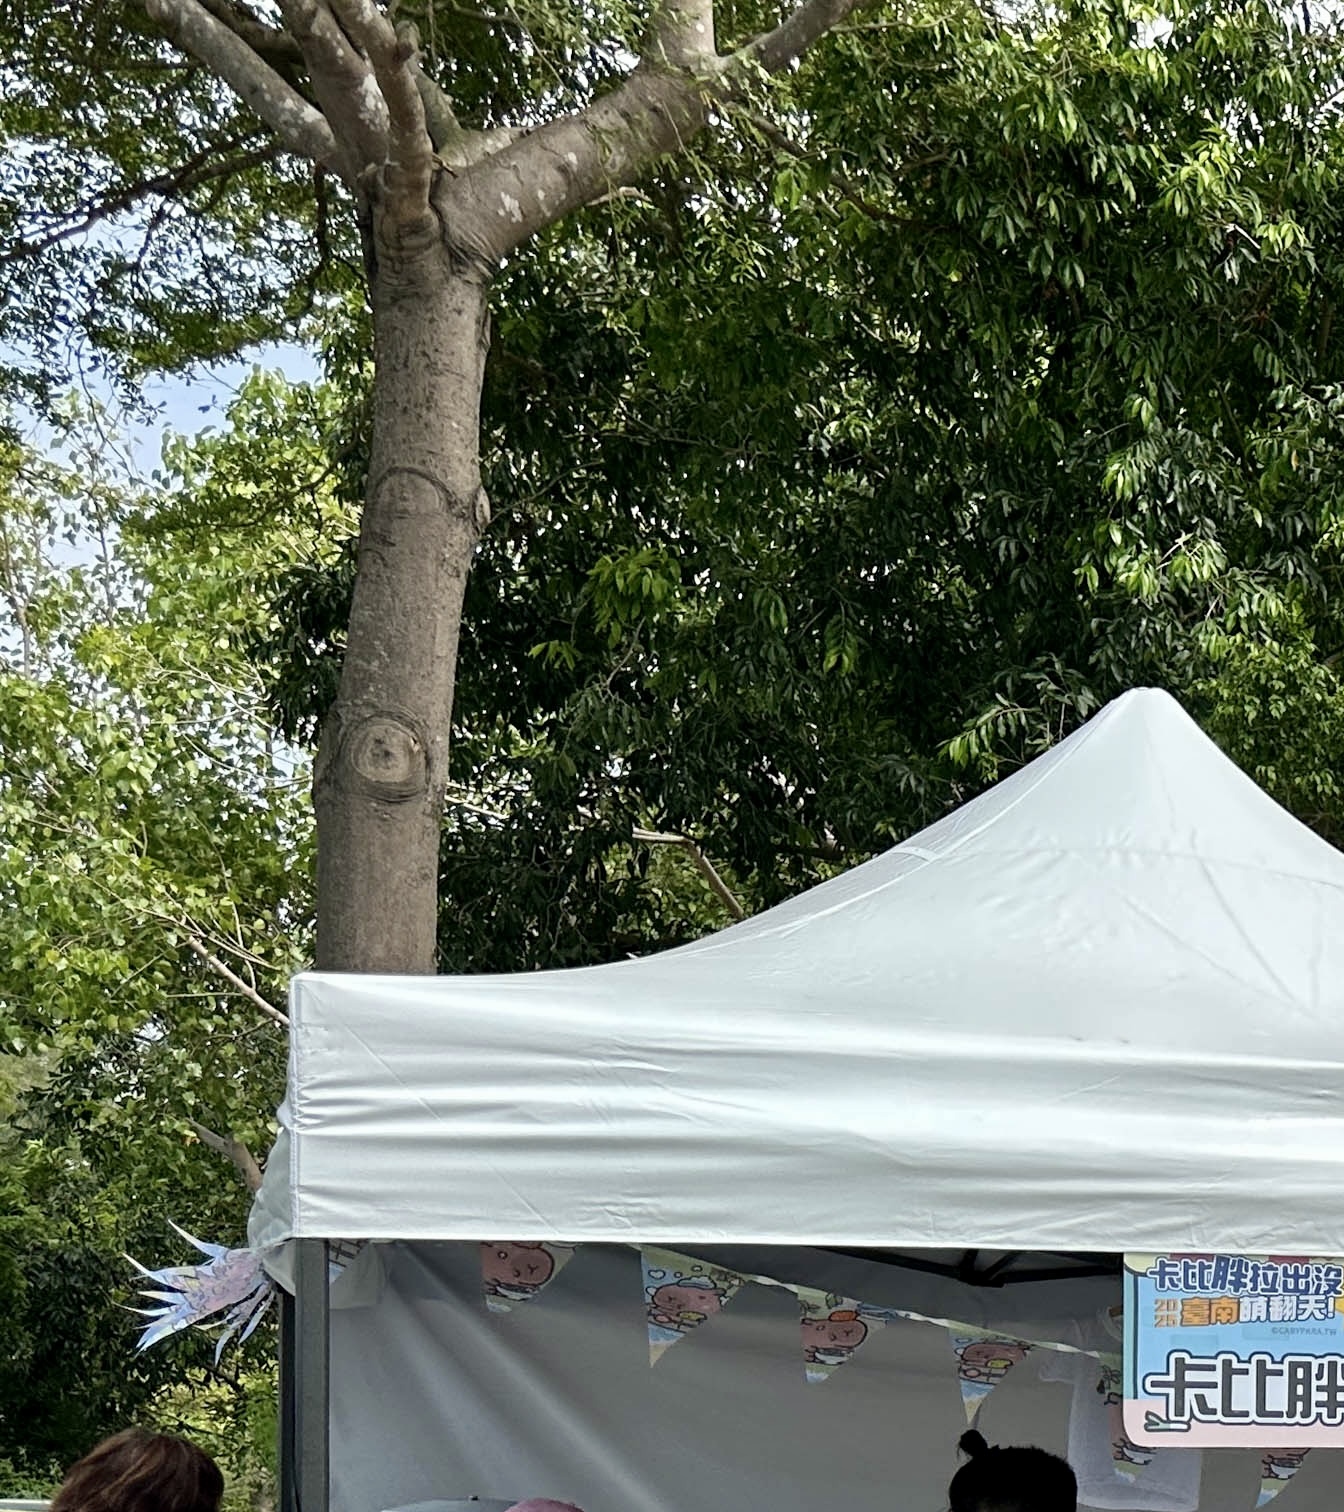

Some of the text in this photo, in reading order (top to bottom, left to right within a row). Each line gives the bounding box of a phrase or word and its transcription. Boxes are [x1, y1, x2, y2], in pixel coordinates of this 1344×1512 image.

[1148, 1256, 1343, 1297] 卡比胖拉出沒
